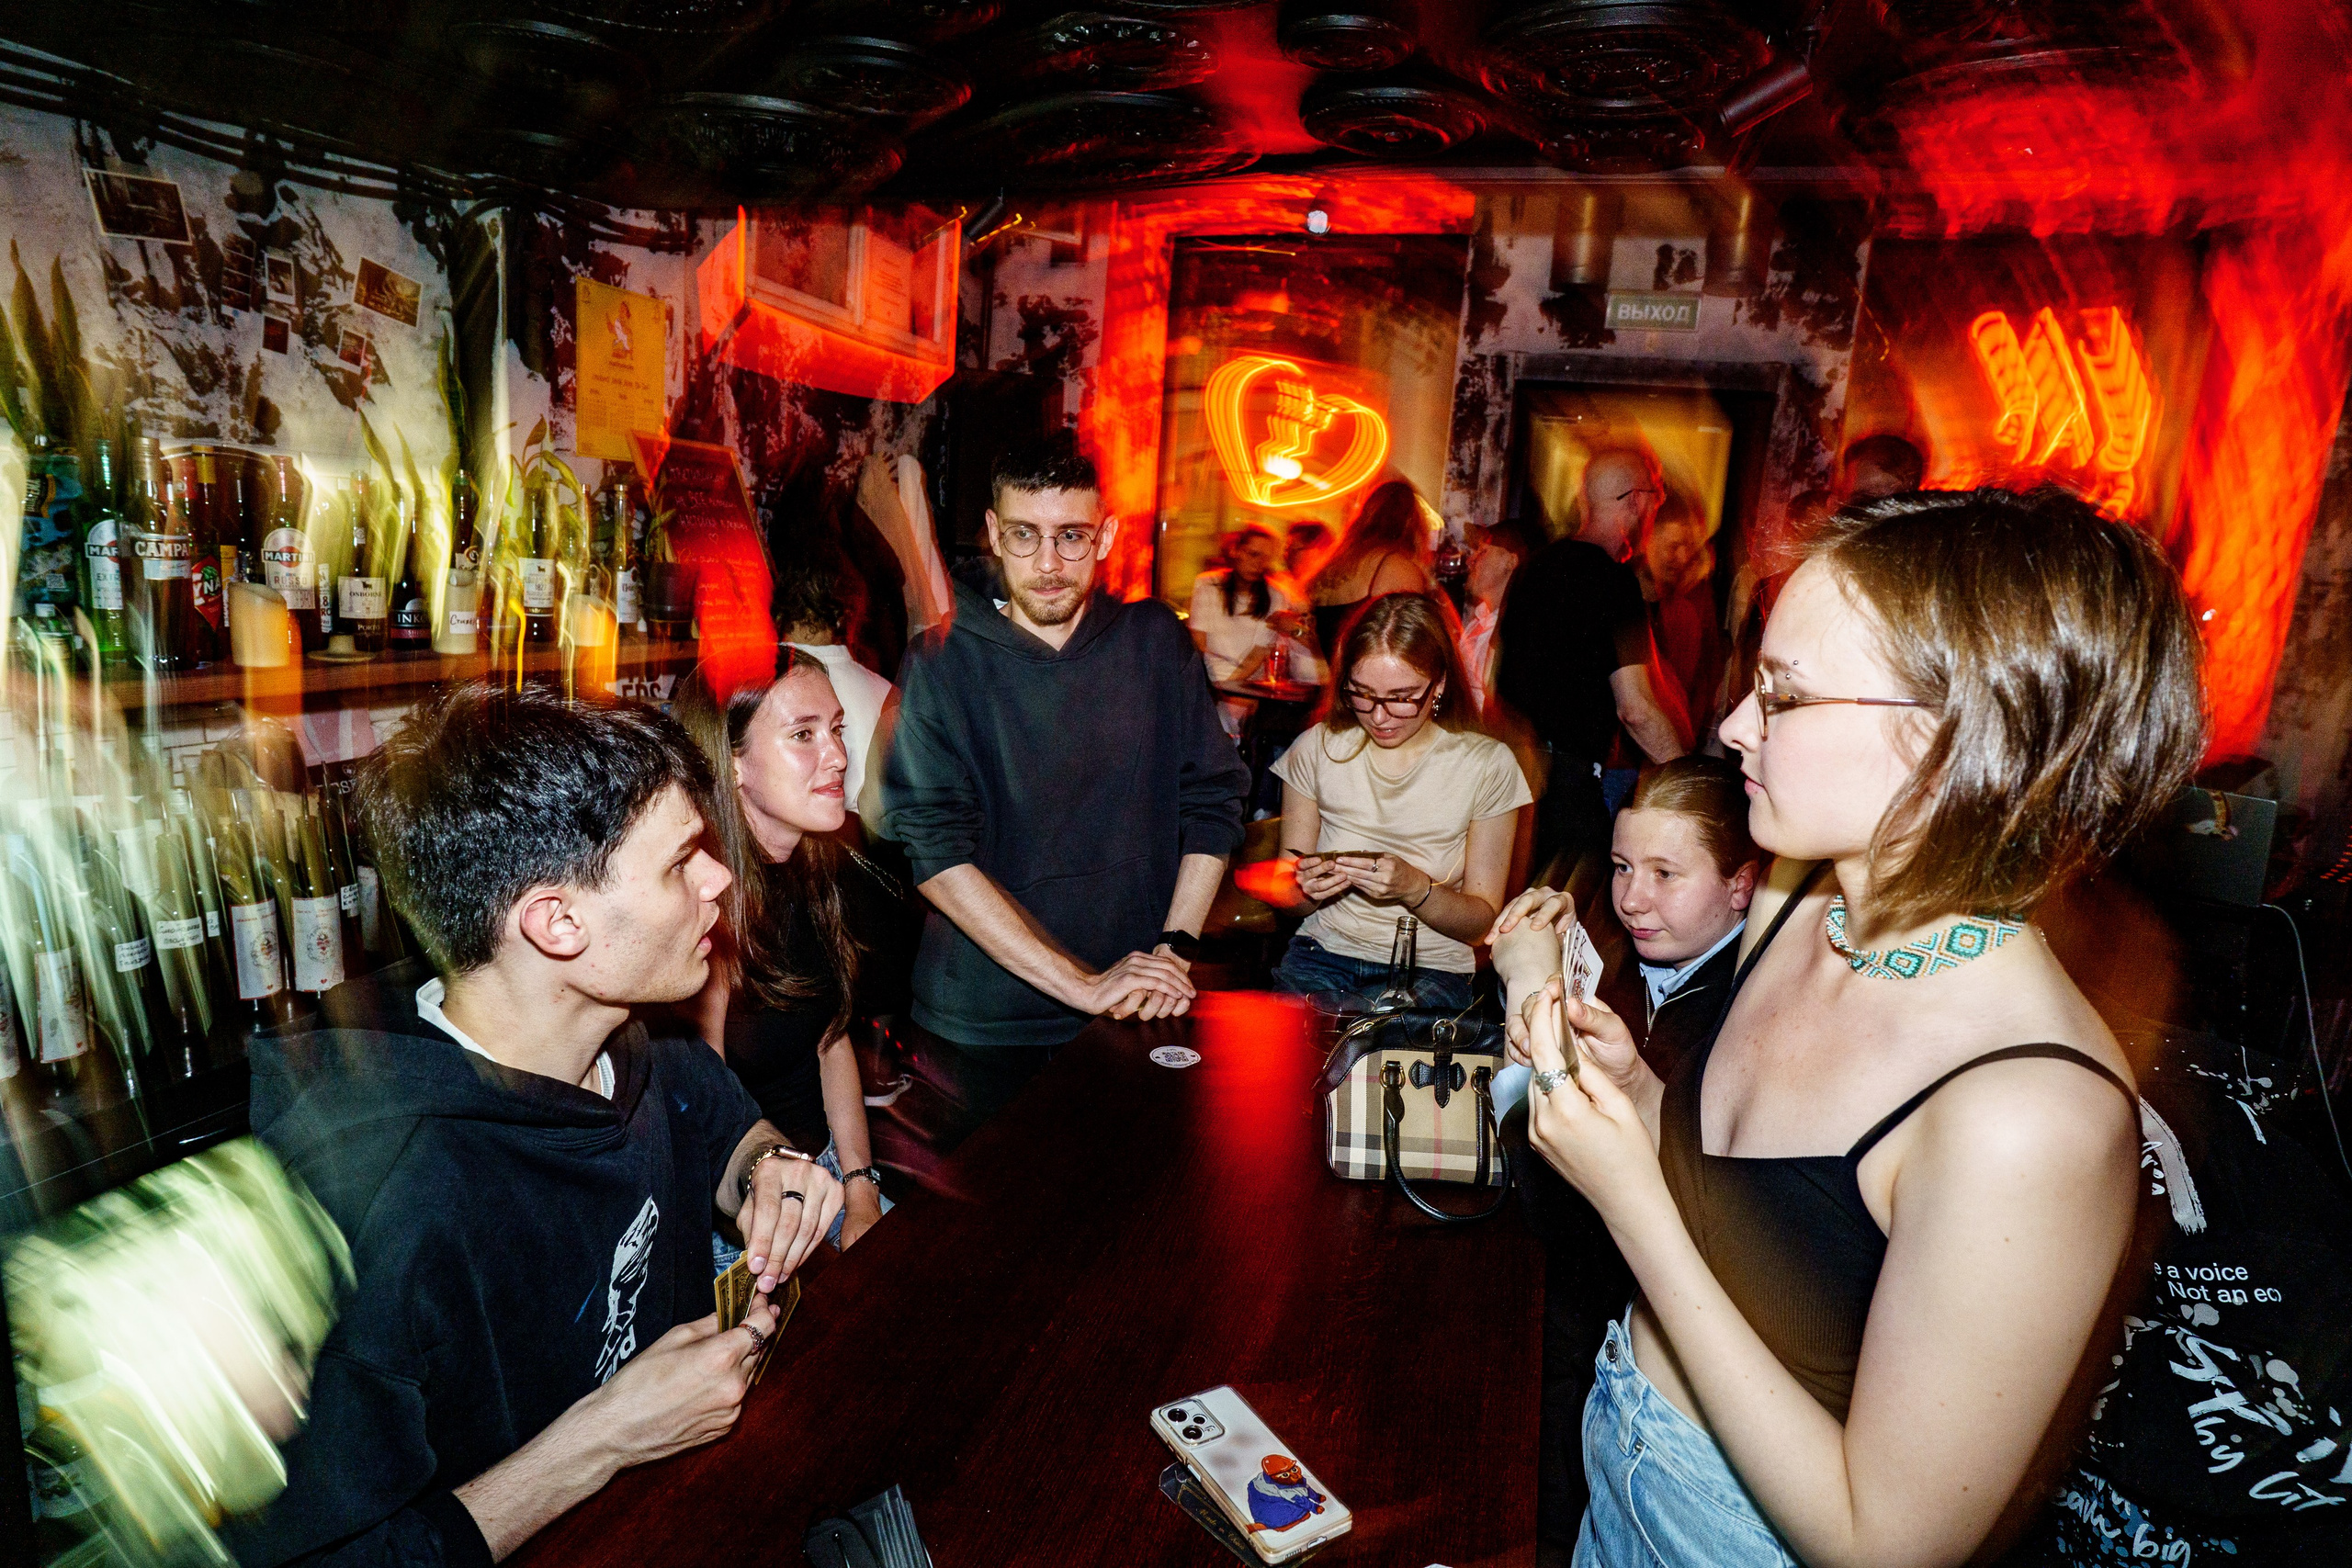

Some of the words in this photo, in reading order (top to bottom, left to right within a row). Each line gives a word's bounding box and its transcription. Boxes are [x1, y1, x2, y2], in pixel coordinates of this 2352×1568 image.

[1617, 303, 1690, 321] ВЫХОД
[265, 552, 313, 562] MARTINI
[274, 576, 308, 585] ROSSO
[2166, 1266, 2180, 1279] a
[2185, 1262, 2249, 1281] voice
[2167, 1280, 2211, 1302] Not
[2216, 1289, 2248, 1303] an
